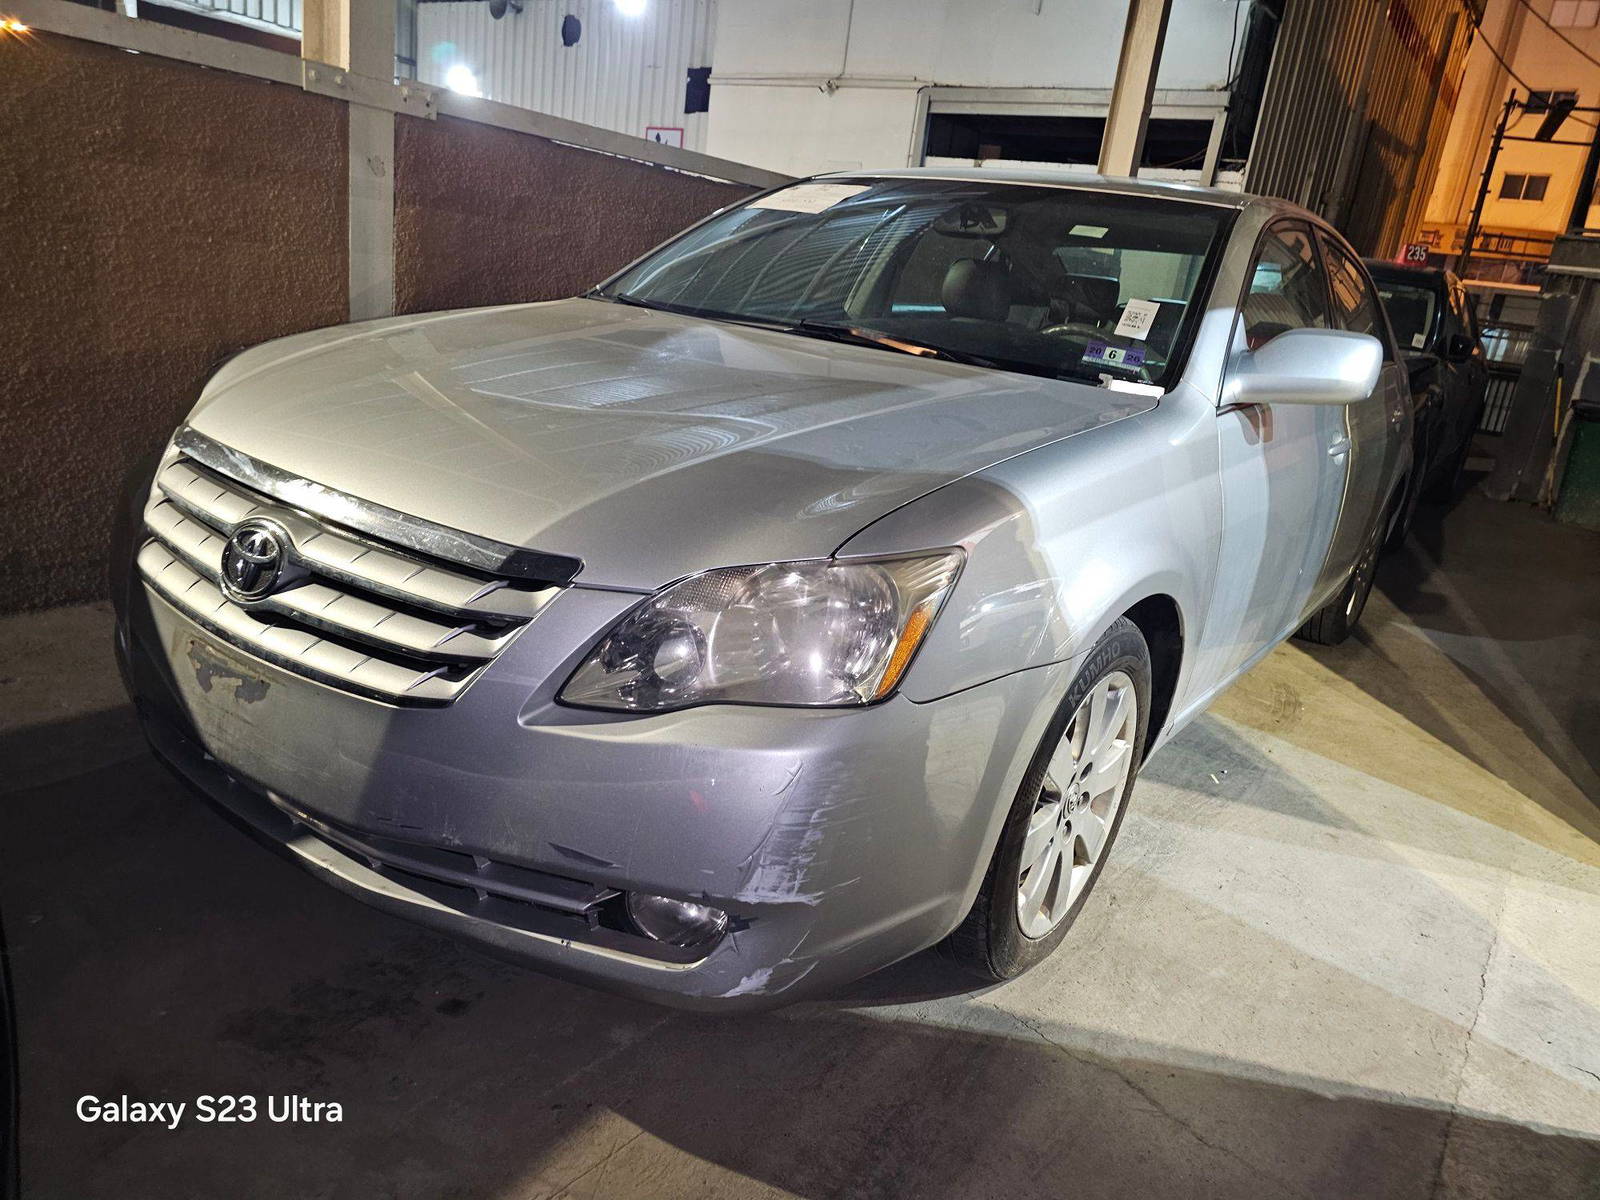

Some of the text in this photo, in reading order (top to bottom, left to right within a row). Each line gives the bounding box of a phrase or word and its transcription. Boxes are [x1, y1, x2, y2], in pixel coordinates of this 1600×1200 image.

[1407, 245, 1426, 261] 235
[1109, 350, 1117, 359] 6
[1068, 641, 1120, 708] KUMHO
